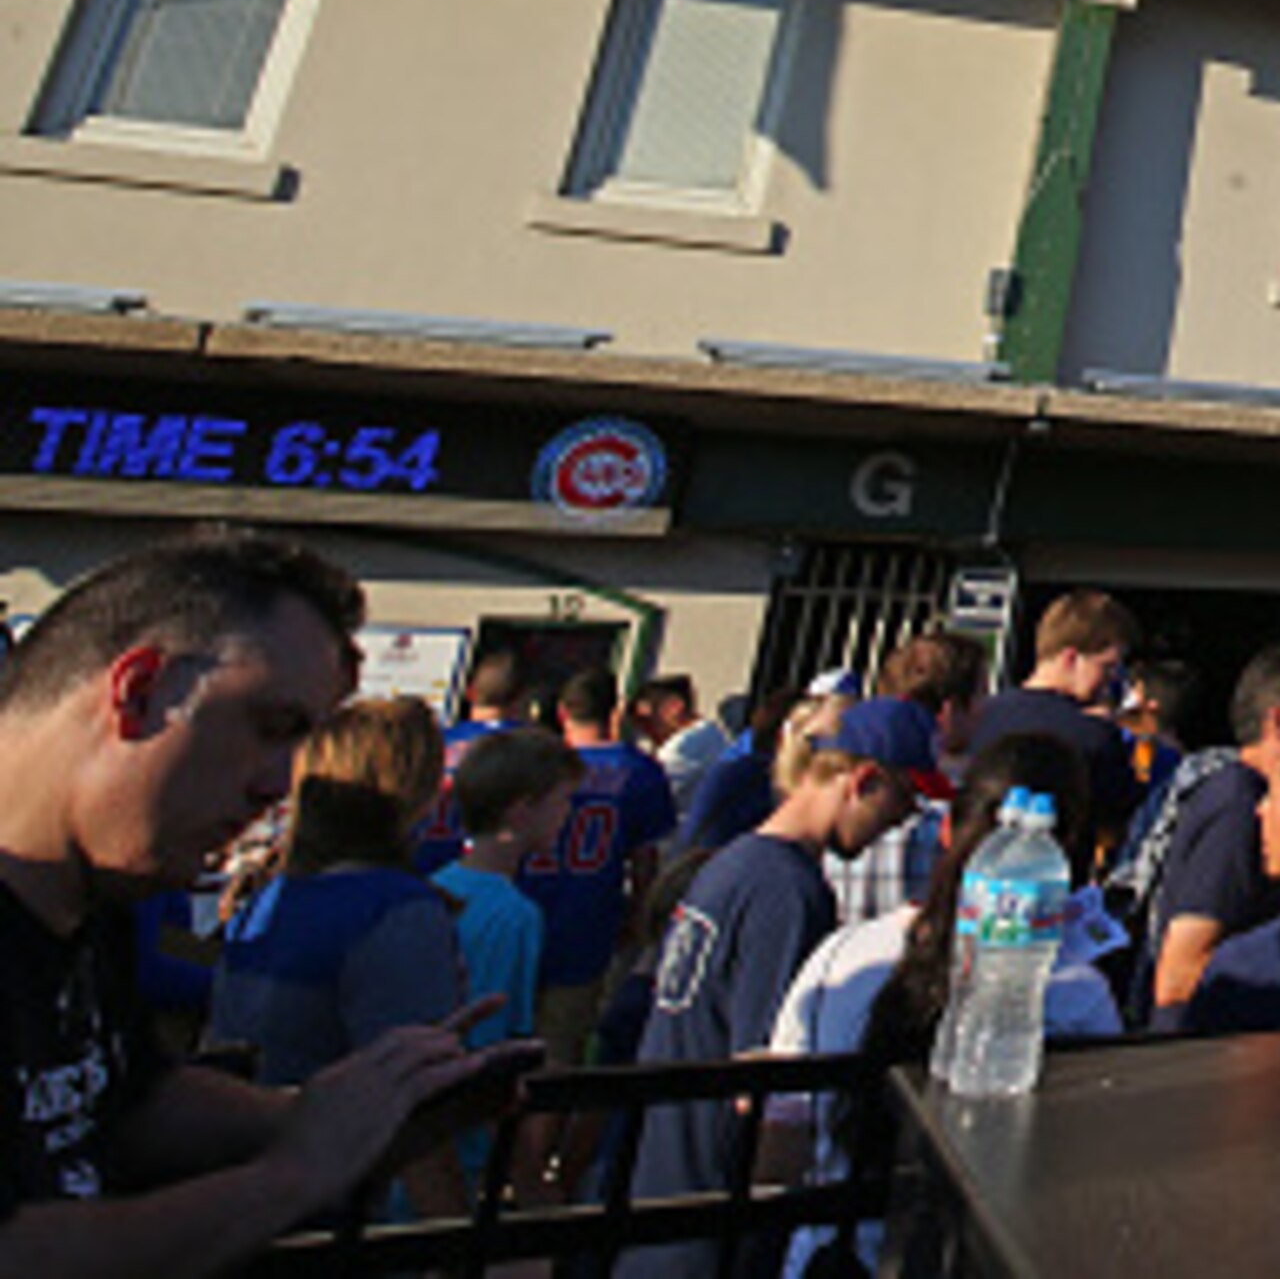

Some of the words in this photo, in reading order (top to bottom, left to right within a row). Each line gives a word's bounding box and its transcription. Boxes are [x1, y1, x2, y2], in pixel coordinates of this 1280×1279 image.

[31, 406, 248, 481] TIME
[264, 422, 441, 491] 6:54
[850, 450, 917, 518] G
